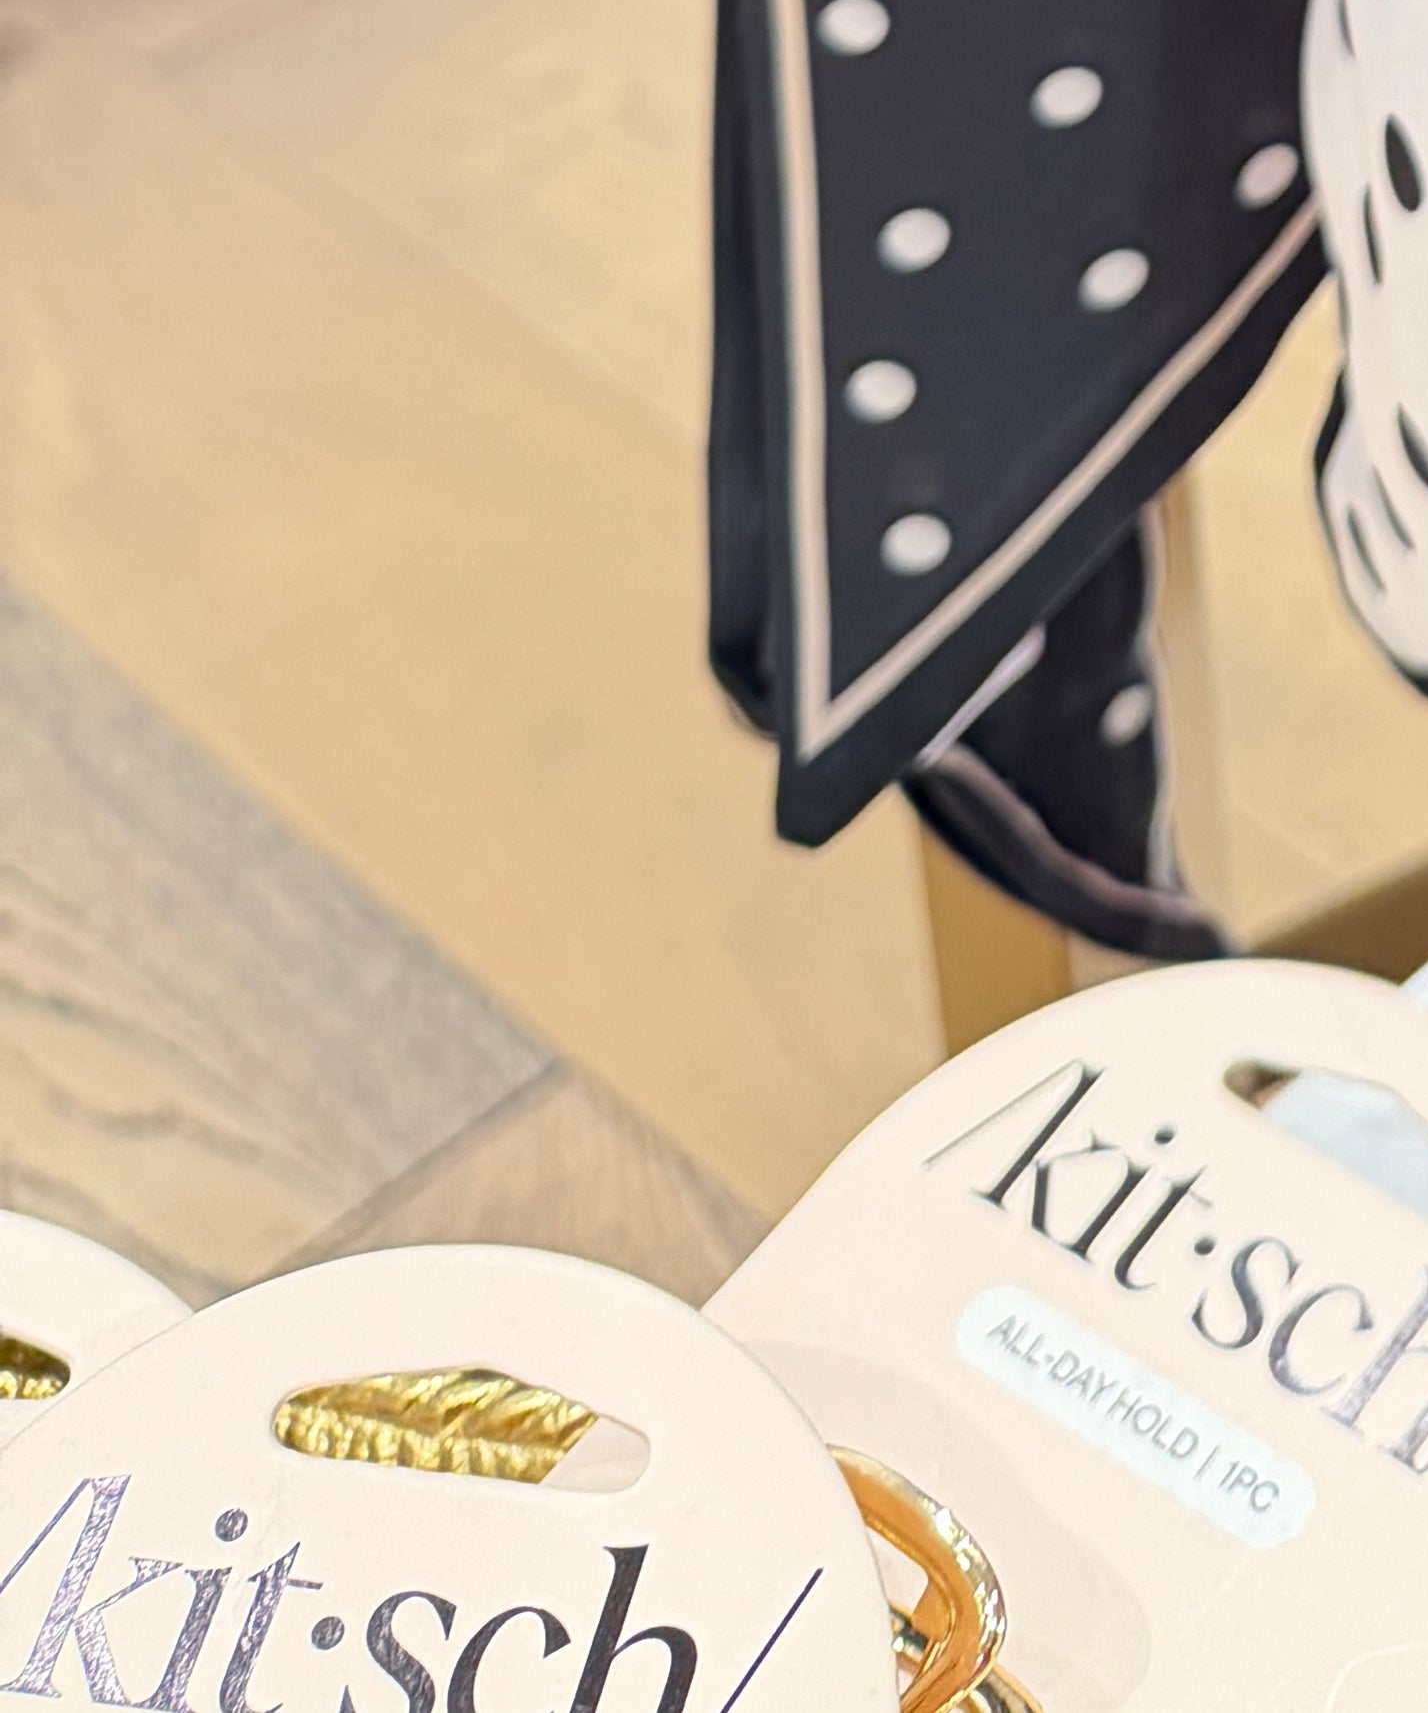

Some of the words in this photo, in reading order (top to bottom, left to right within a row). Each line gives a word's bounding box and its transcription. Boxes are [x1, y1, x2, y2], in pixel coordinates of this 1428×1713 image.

[986, 1314, 1117, 1405] ALL-DAY
[1105, 1386, 1200, 1460] HOLD
[1218, 1460, 1280, 1513] 1PC
